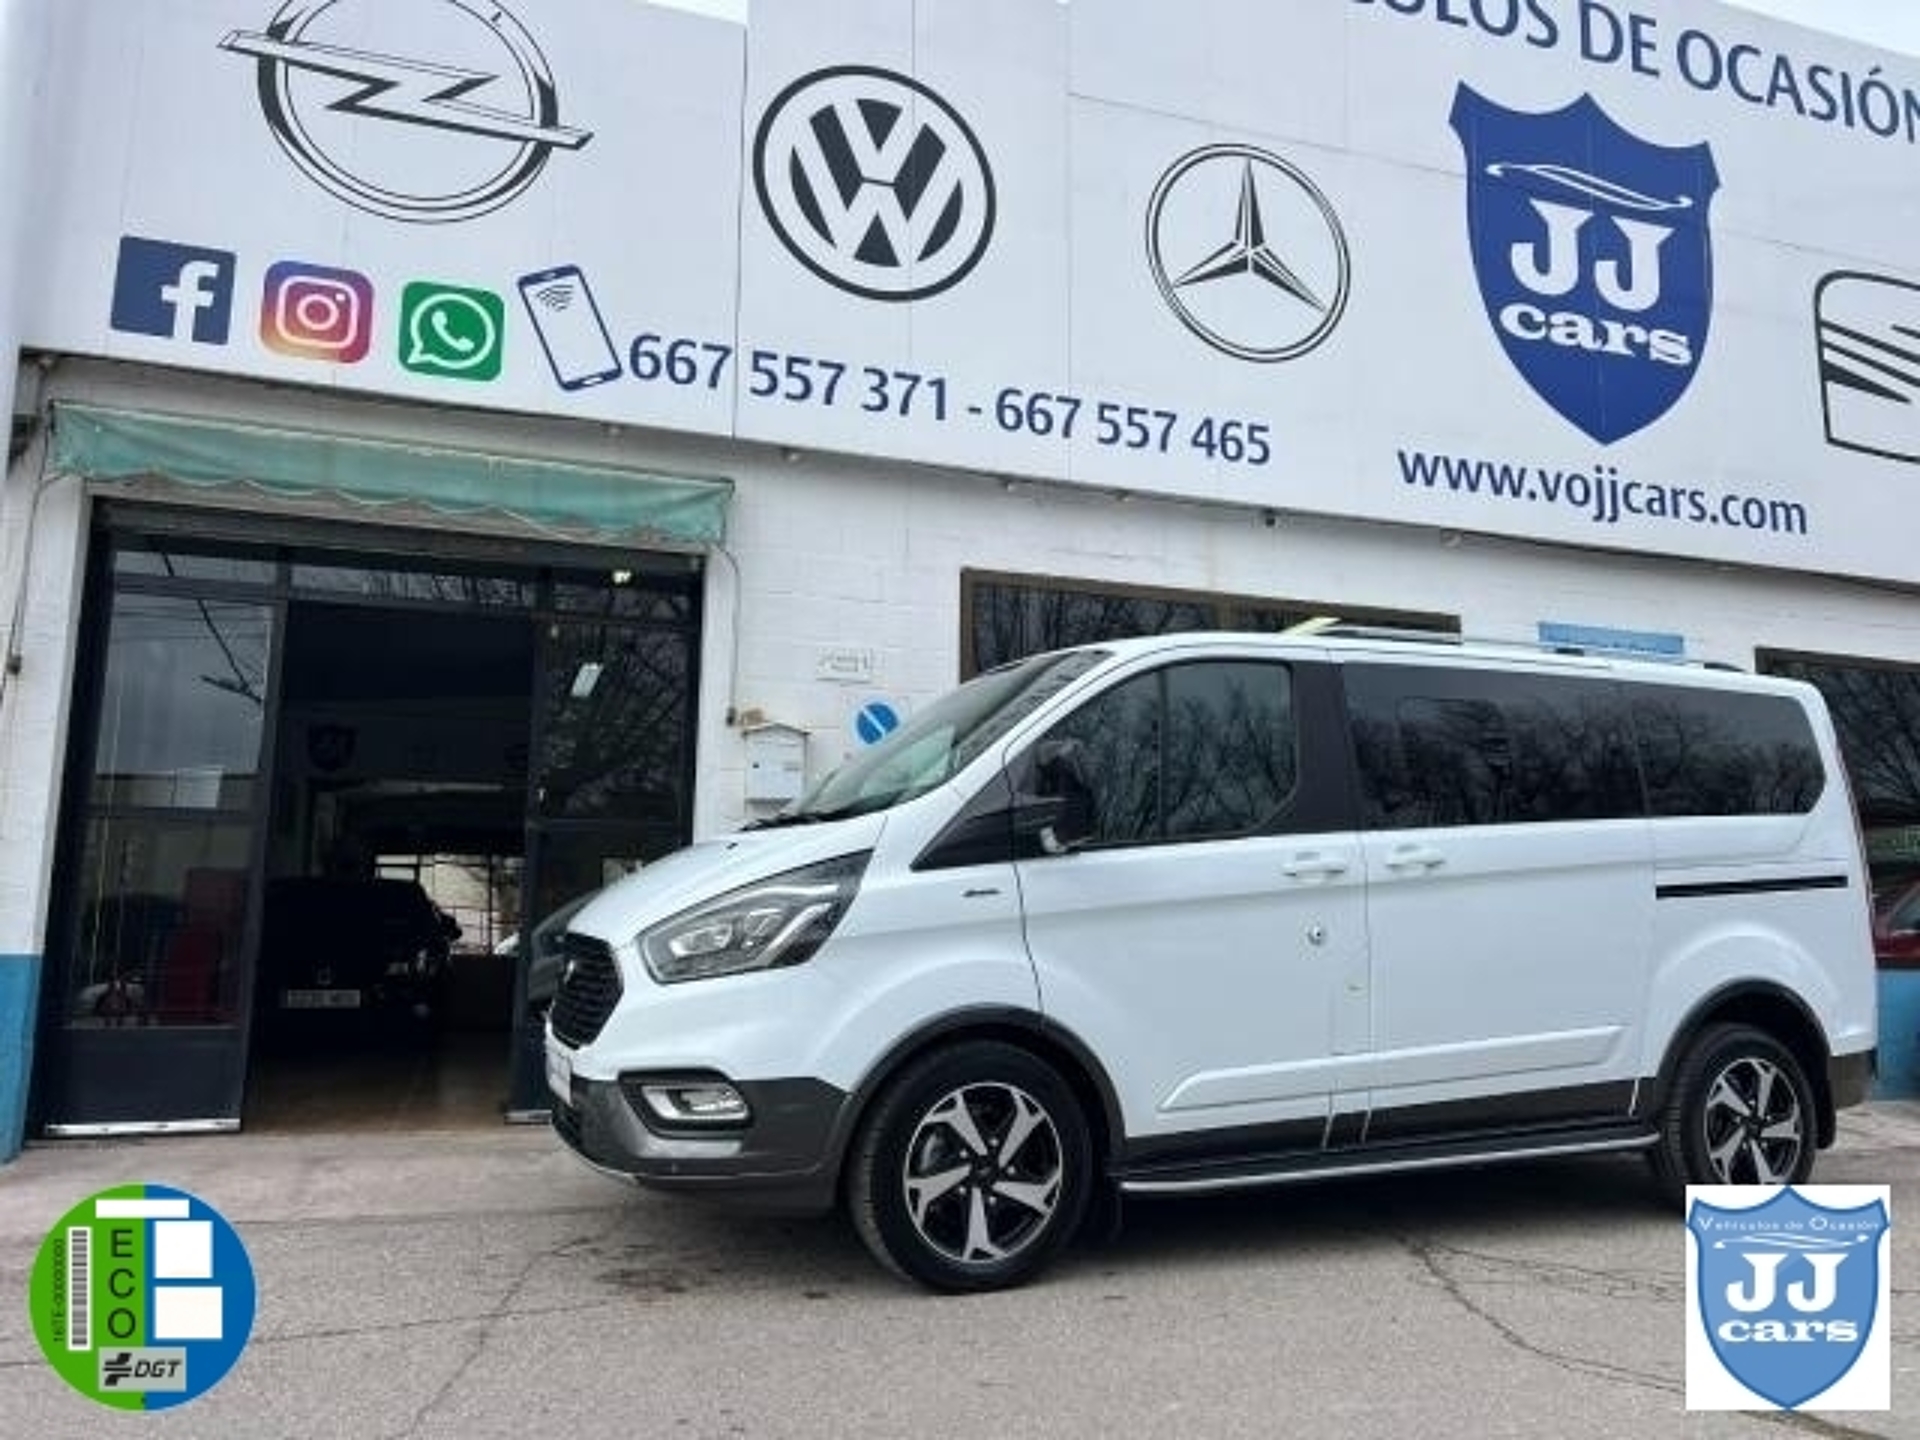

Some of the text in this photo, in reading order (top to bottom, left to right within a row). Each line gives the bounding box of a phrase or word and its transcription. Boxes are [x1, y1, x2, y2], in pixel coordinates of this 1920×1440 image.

[1350, 0, 1560, 49] LOS
[1580, 0, 1661, 78] DE
[1511, 199, 1676, 312] JJ
[1500, 303, 1692, 365] cars
[628, 334, 732, 388] 667
[749, 351, 846, 406] 557
[861, 368, 948, 421] 371
[995, 388, 1082, 438] 667
[1096, 404, 1177, 453] 557
[1190, 417, 1272, 465] 465
[1398, 449, 1808, 535] www.vojjcars.com
